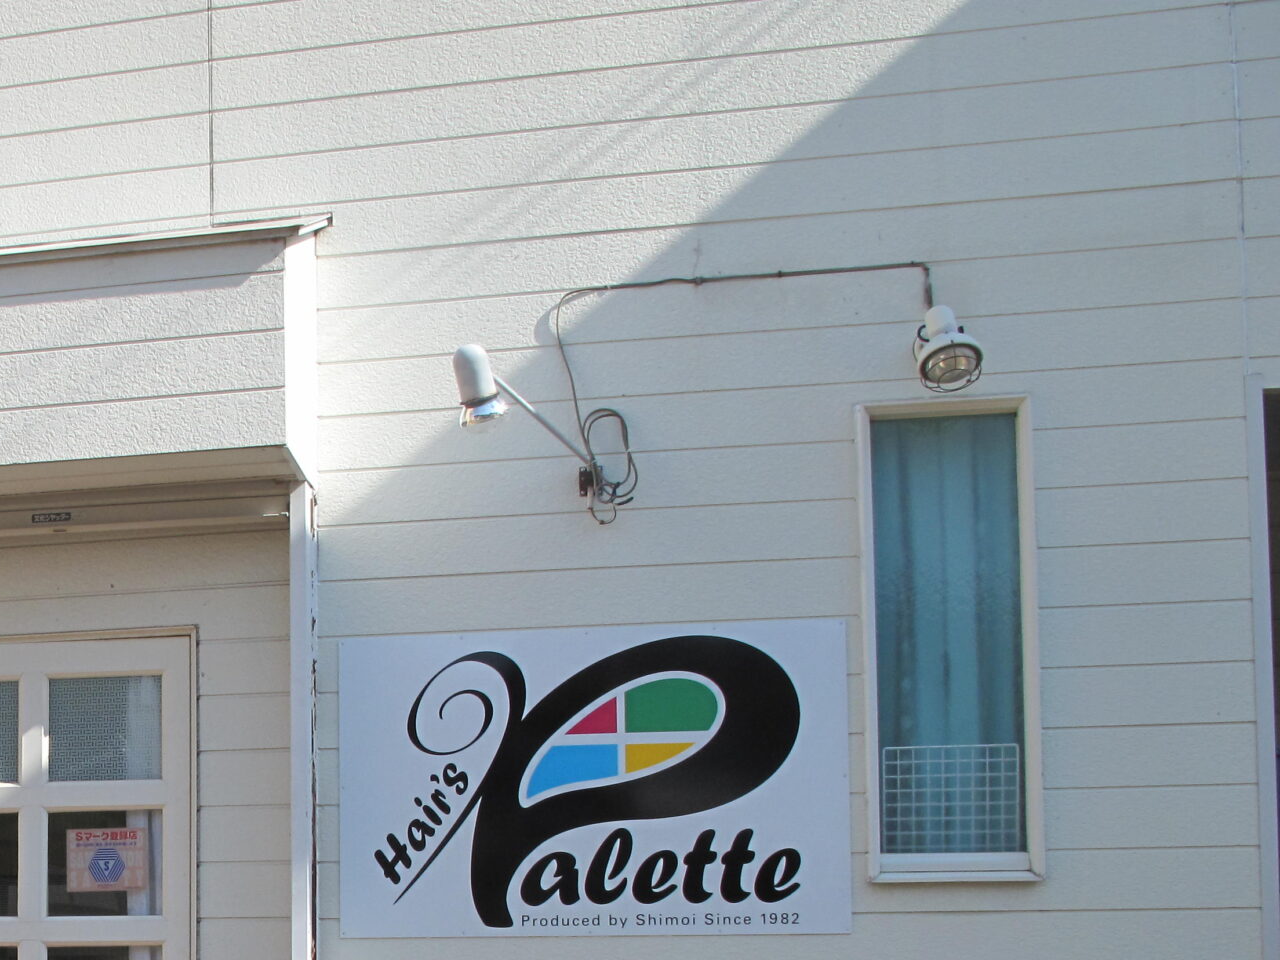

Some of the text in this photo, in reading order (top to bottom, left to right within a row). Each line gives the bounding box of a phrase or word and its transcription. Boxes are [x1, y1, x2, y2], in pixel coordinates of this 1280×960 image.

[373, 763, 469, 885] Hair's
[521, 912, 801, 928] Produced by Shimoi Since 1982
